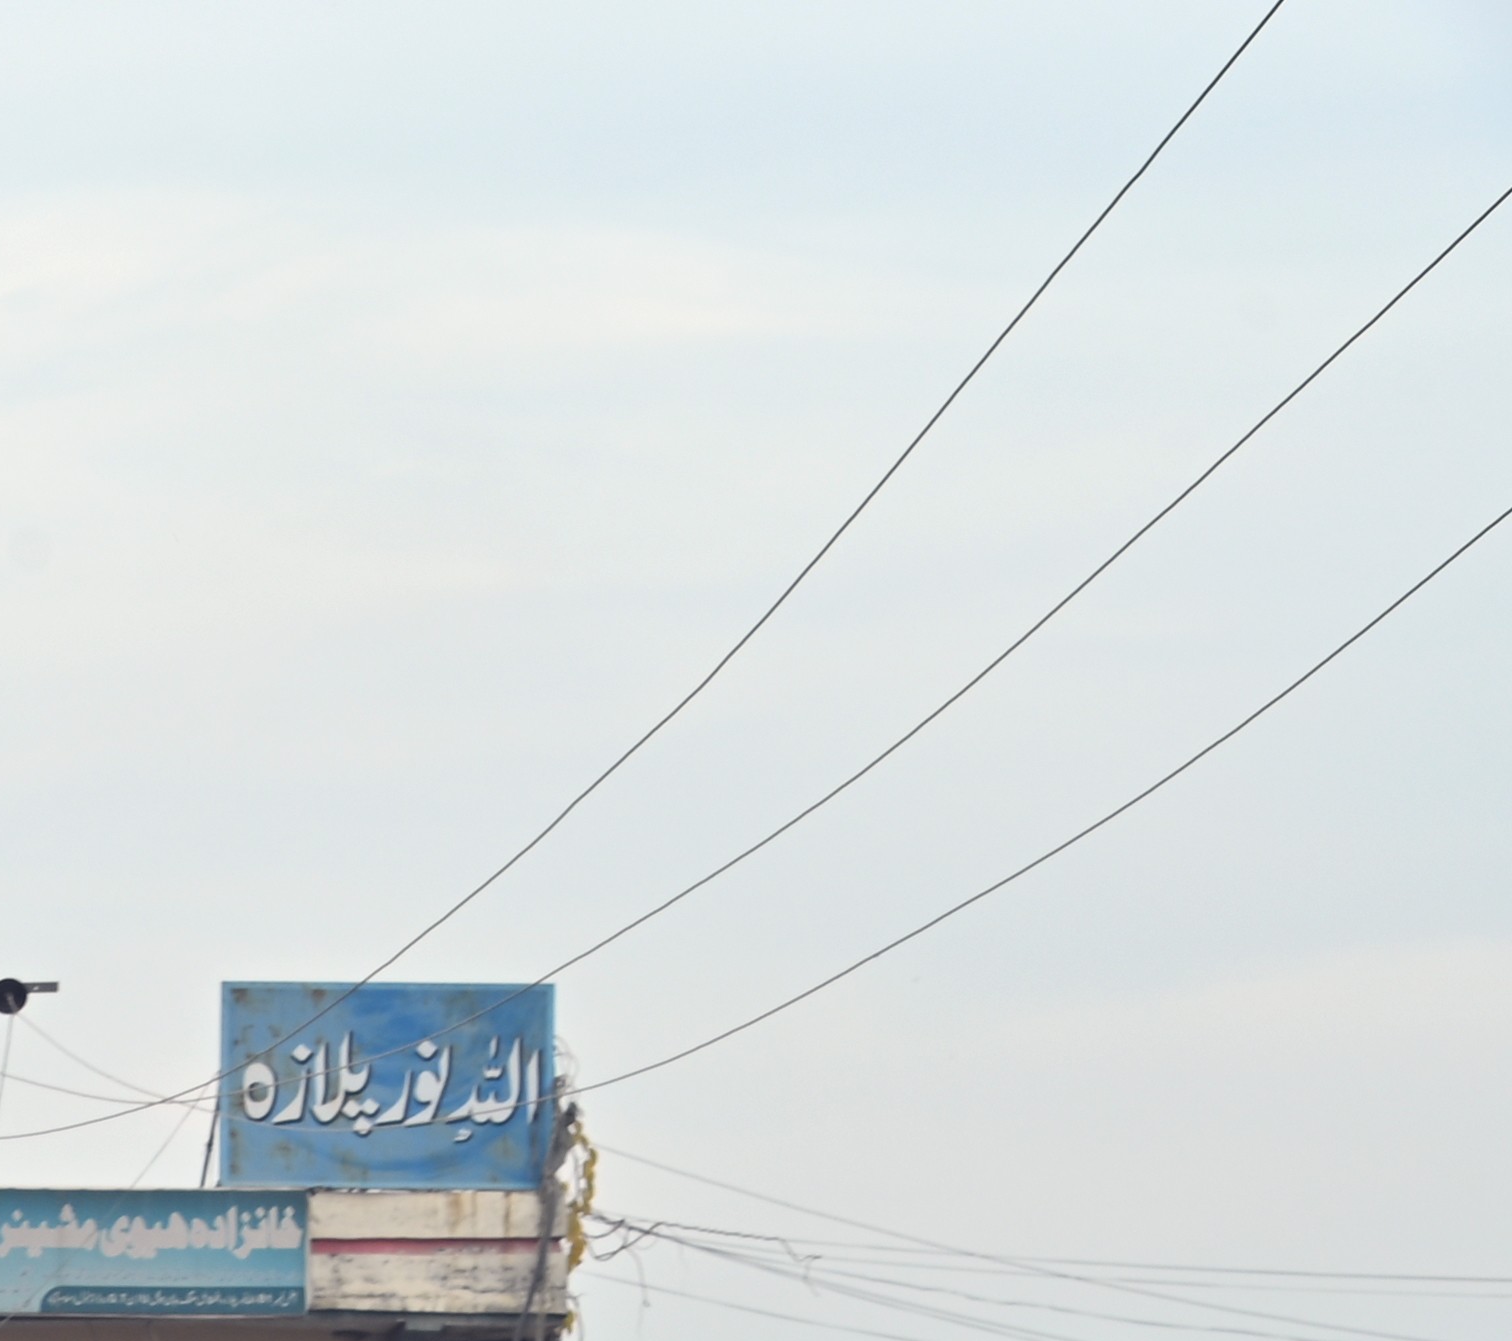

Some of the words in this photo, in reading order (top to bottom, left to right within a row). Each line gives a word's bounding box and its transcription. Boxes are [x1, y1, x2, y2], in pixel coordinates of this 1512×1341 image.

[242, 1030, 372, 1137] پلازہ
[373, 1040, 453, 1129] نور
[190, 1204, 303, 1259] خانزادہ
